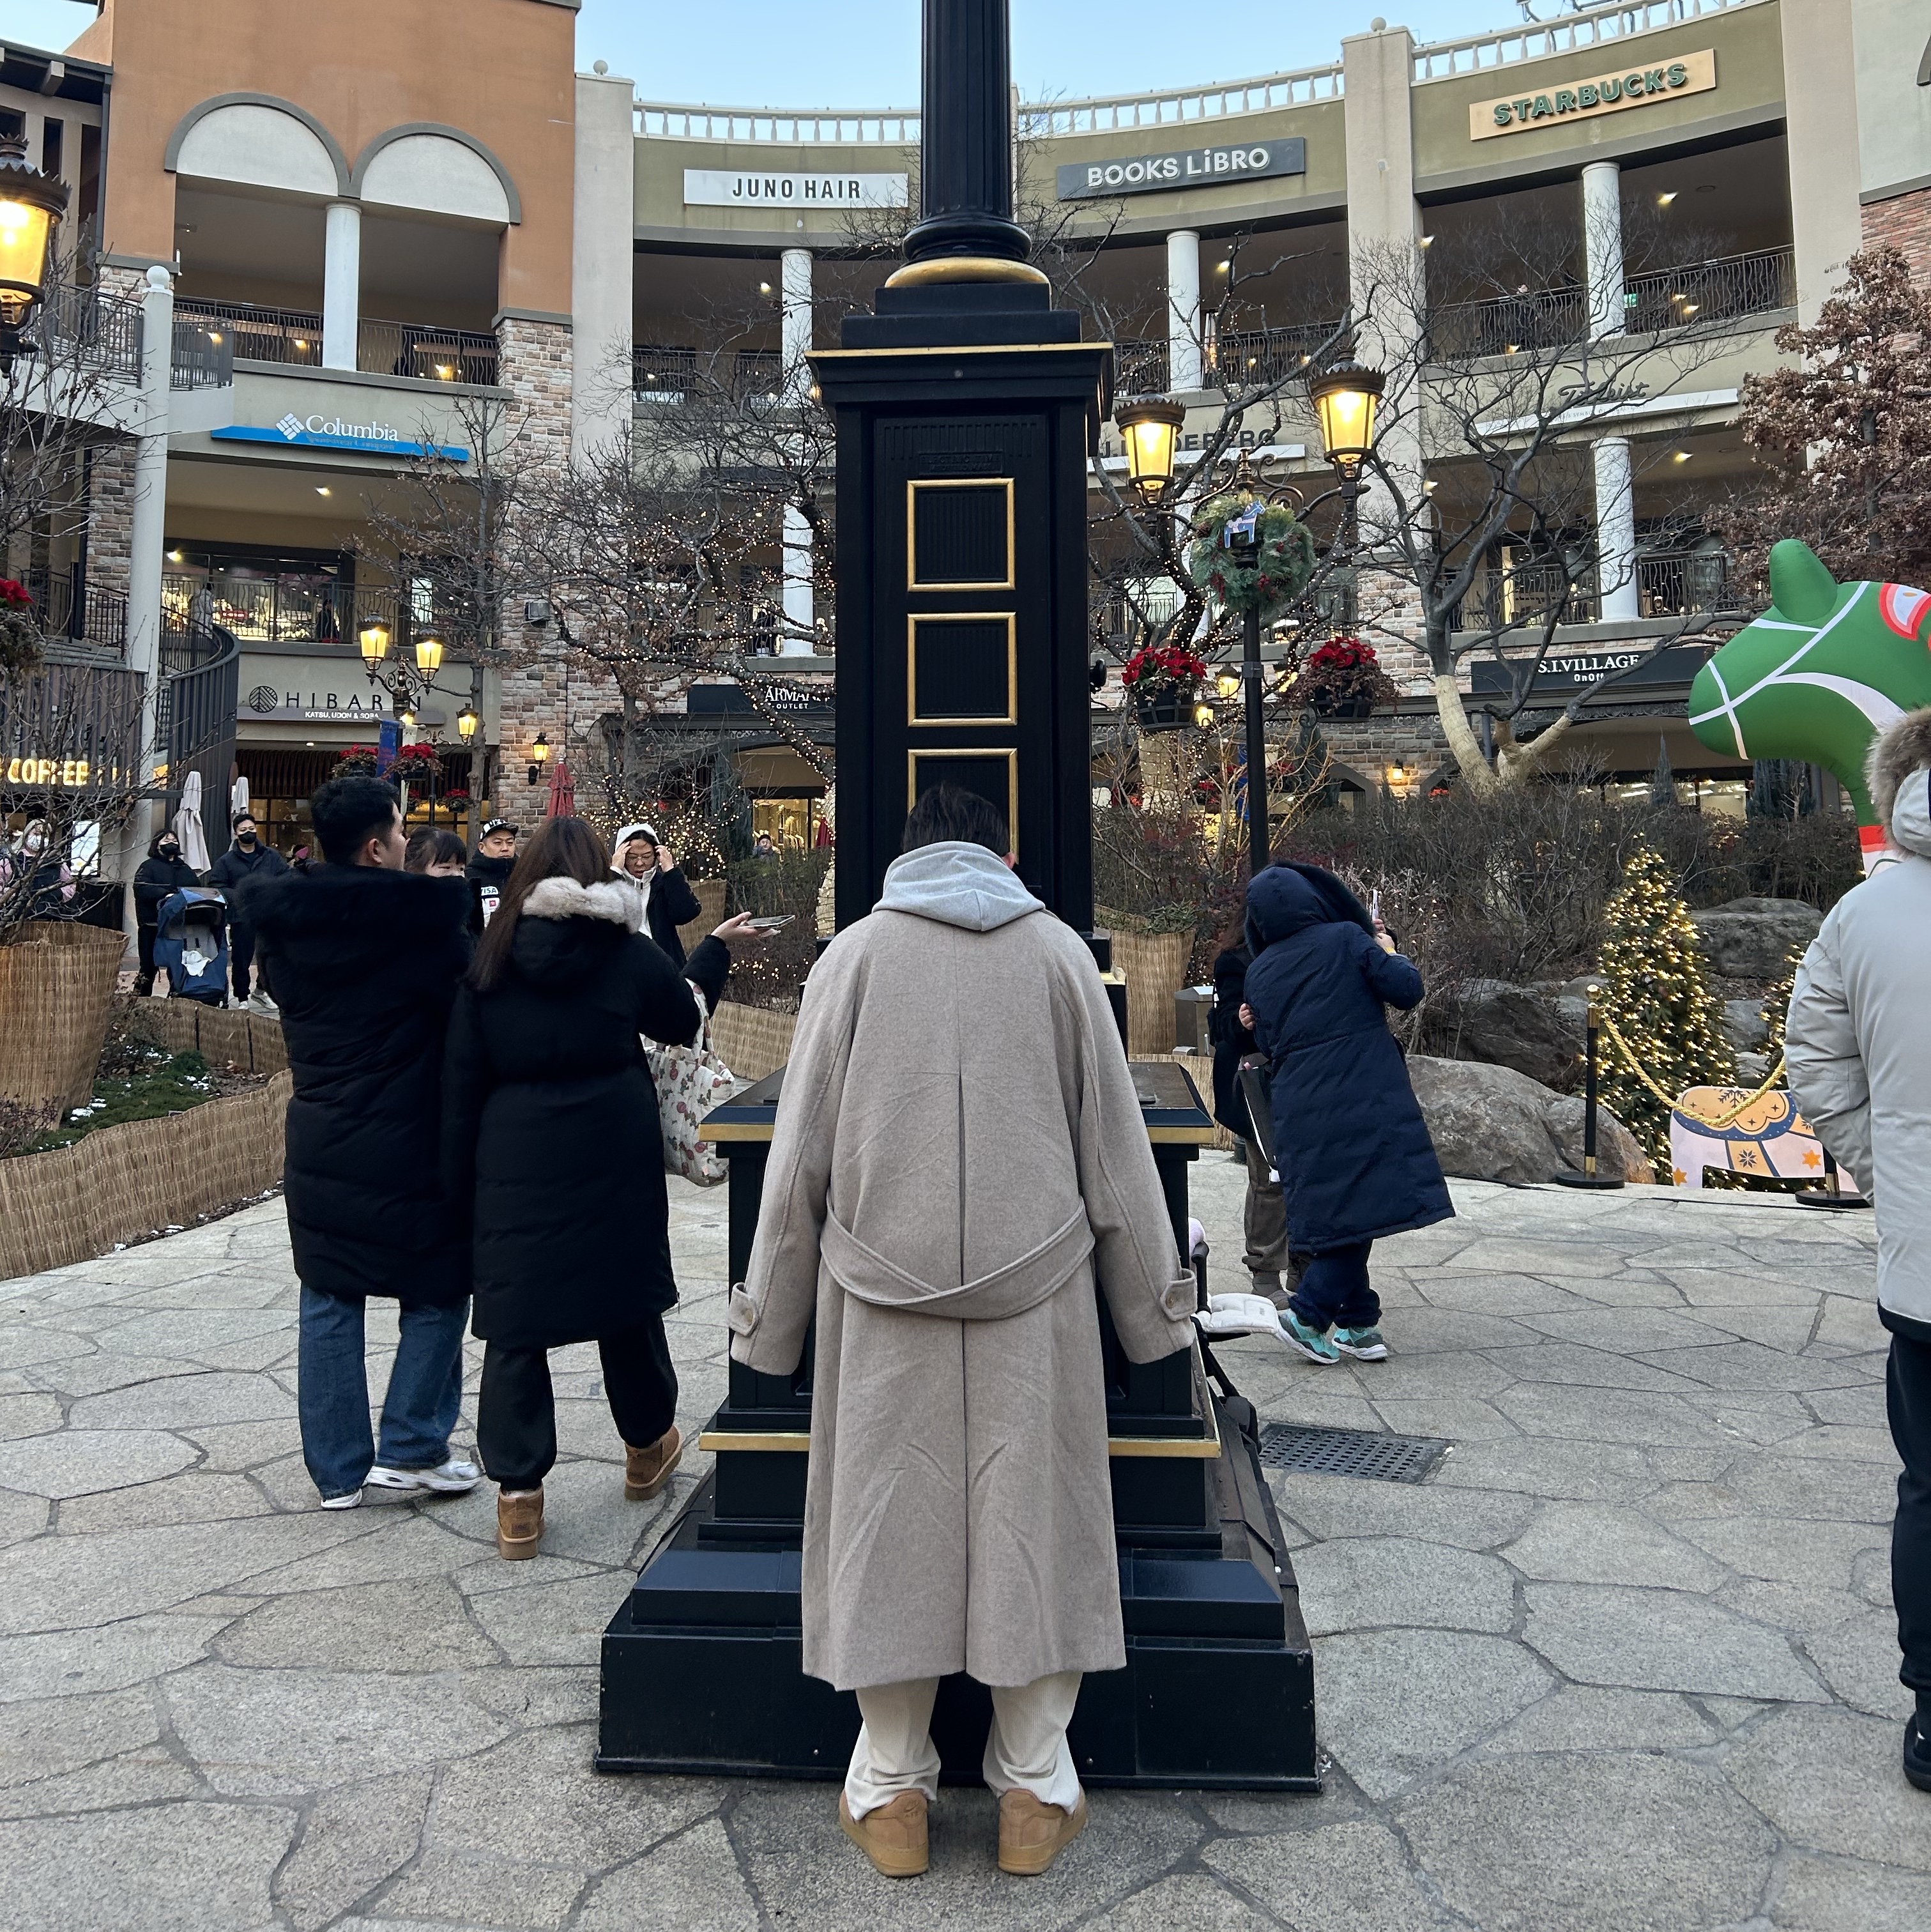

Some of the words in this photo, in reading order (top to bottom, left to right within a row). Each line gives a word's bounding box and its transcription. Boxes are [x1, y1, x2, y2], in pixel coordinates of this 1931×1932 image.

[1493, 63, 1687, 125] STARBUCKS
[1087, 157, 1179, 187] BOOKS
[732, 178, 793, 198] JUNO
[804, 180, 860, 199] HAIR
[305, 415, 399, 441] Columbia
[286, 692, 420, 711] HIBARN
